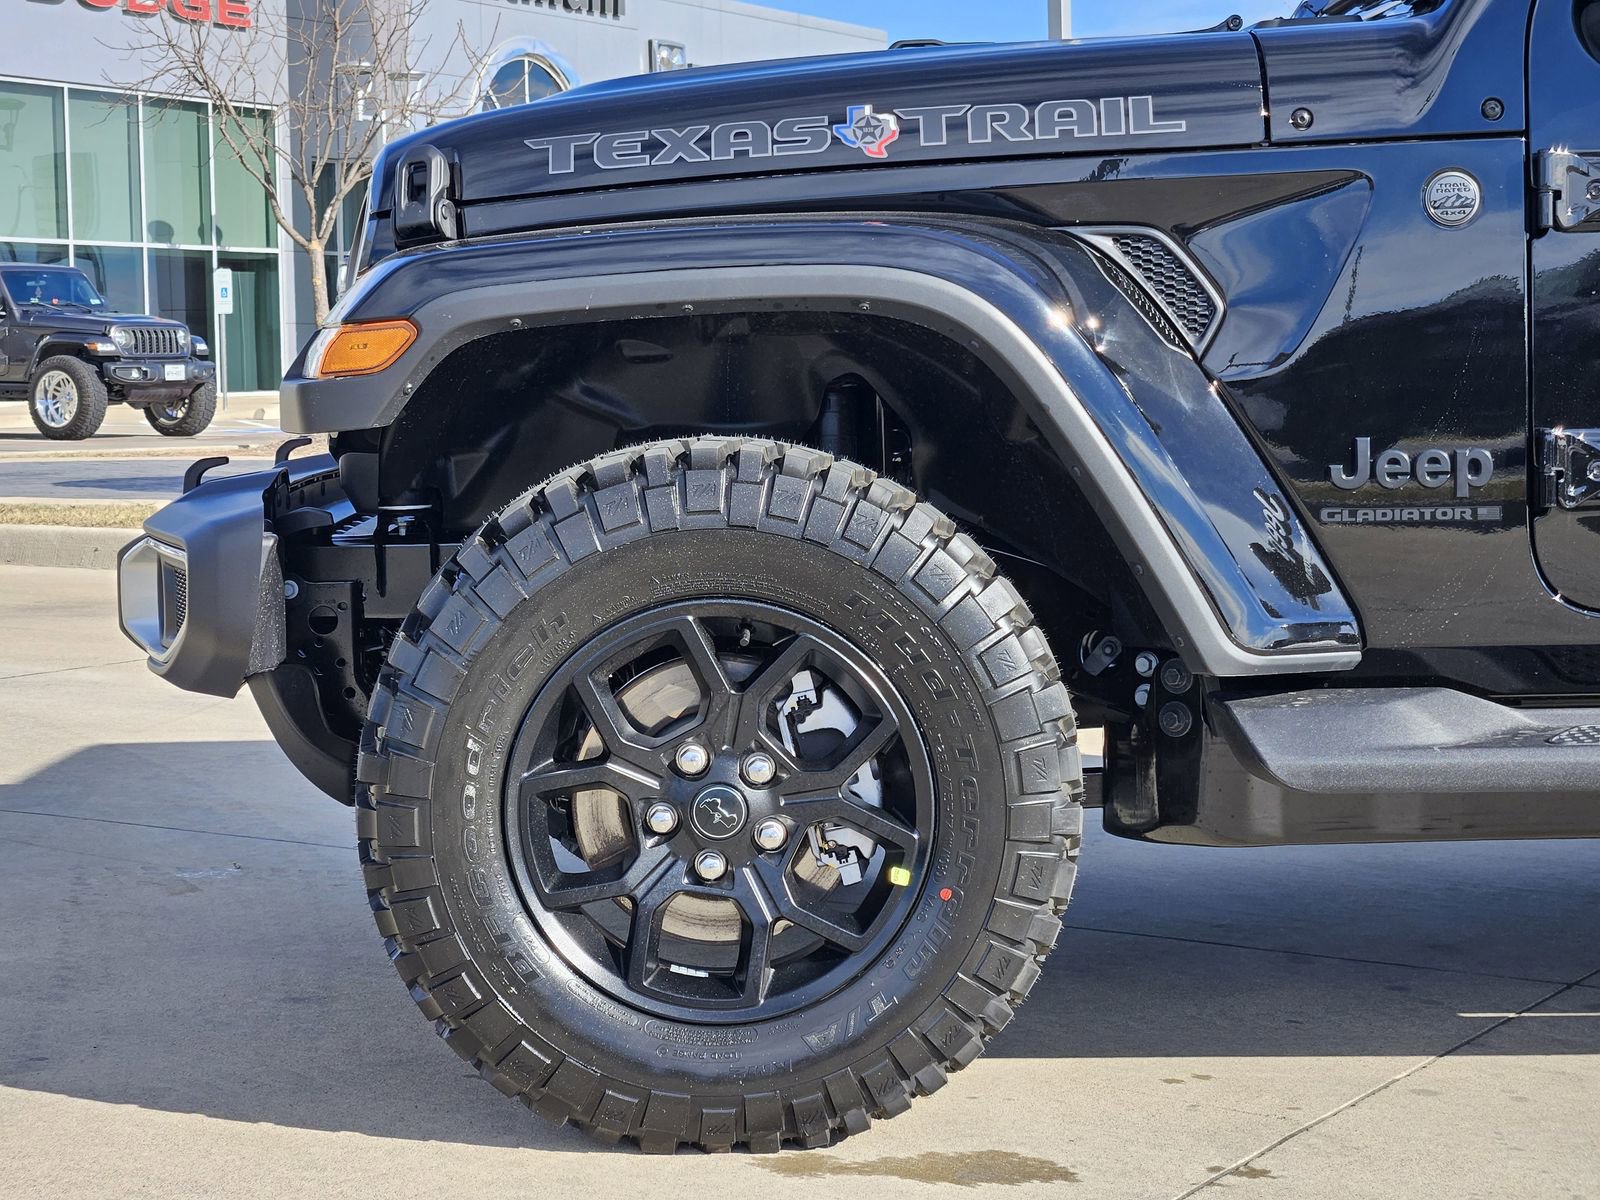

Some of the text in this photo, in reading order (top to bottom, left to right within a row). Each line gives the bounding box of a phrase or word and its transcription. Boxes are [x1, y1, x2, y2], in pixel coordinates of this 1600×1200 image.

[524, 95, 1186, 174] TEXAS TRAIL
[1328, 437, 1494, 498] Jeep
[1320, 507, 1472, 523] GLADIATOR
[800, 989, 899, 1056] T/A
